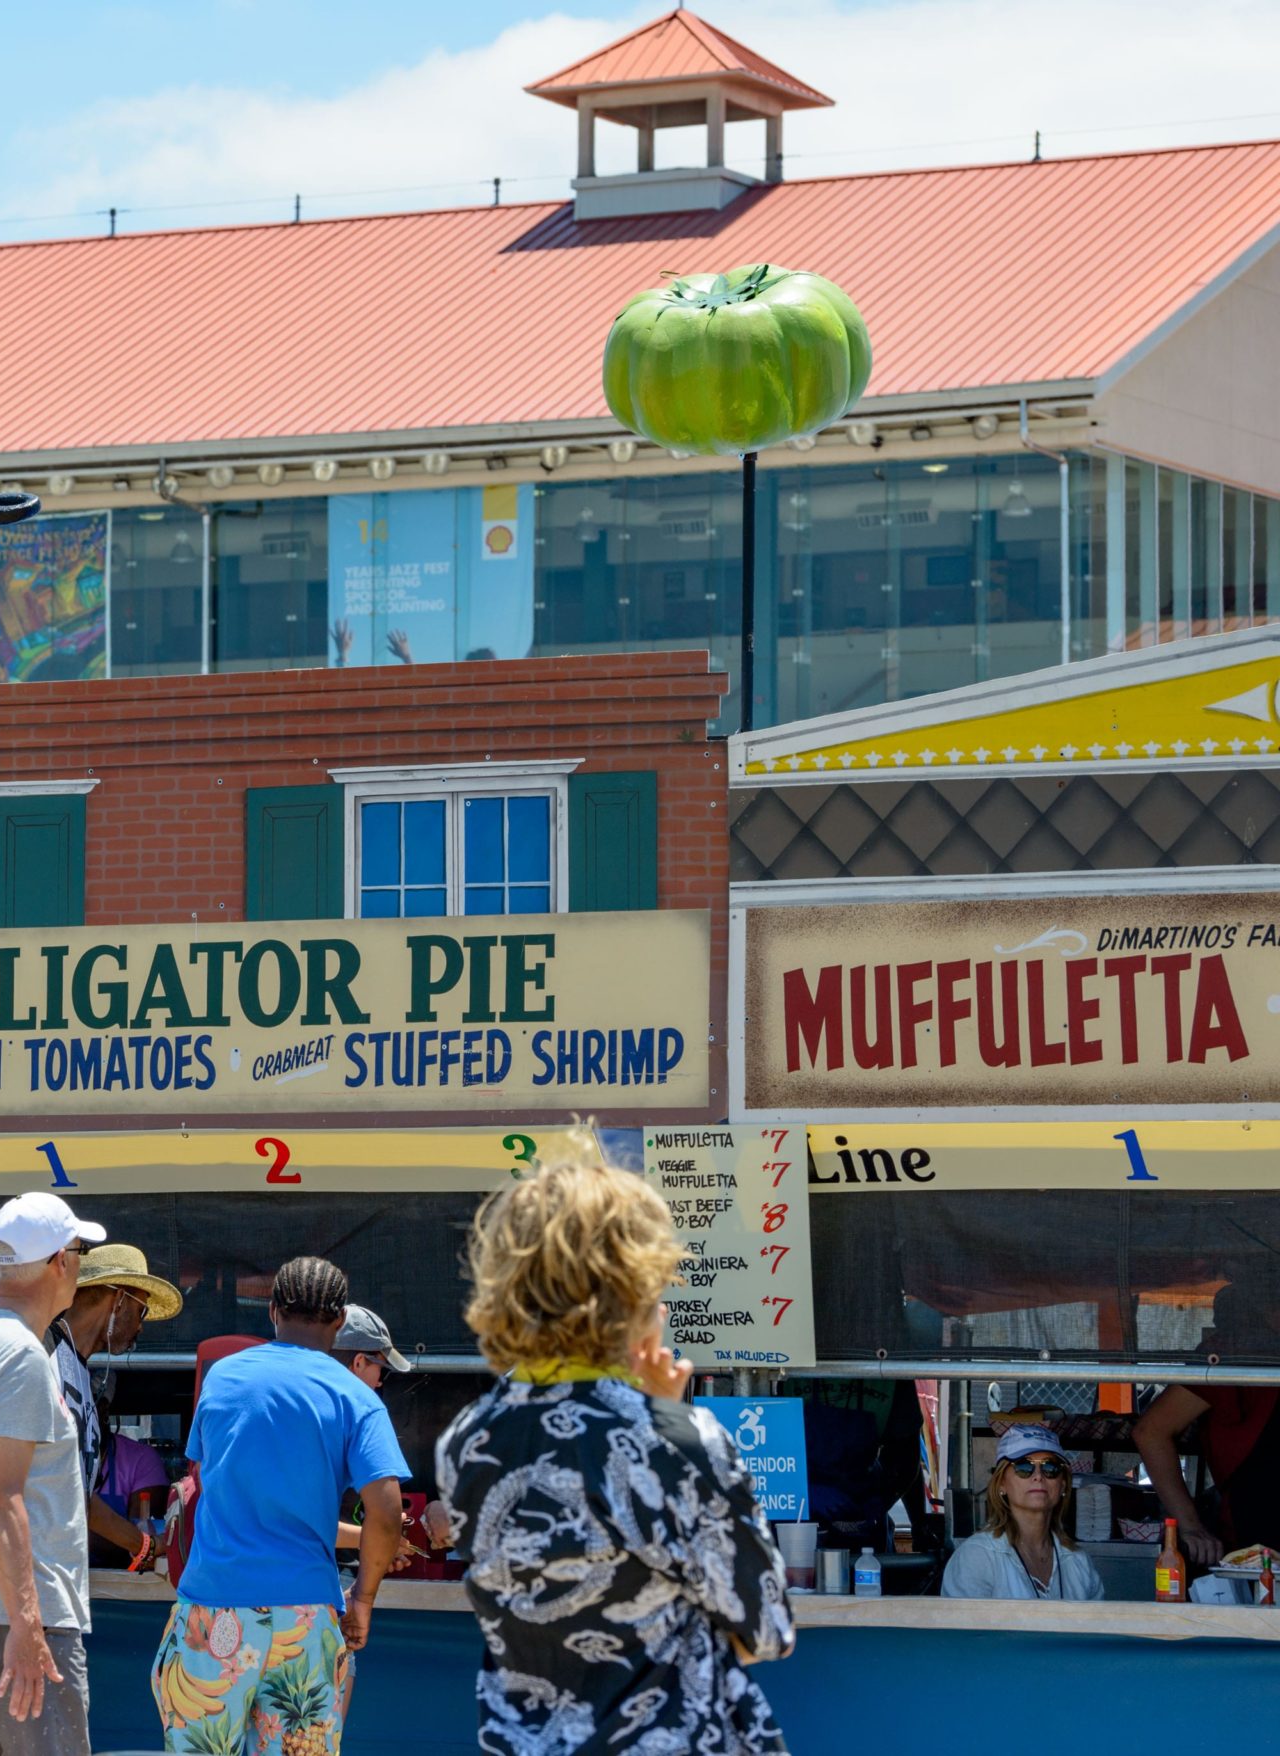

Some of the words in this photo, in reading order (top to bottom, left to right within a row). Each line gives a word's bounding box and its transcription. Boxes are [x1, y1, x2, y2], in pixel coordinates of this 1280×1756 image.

[344, 566, 385, 578] YEARS
[389, 563, 421, 576] JAZZ
[424, 562, 450, 575] FEST
[345, 576, 421, 590] PRESENTING
[345, 603, 373, 615] AND
[376, 599, 445, 614] COUNTING
[1247, 924, 1280, 947] FA
[405, 933, 555, 1023] PIE
[783, 953, 1250, 1073] MUFFULETTA
[24, 1034, 216, 1092] TOMATOES
[252, 1034, 335, 1081] CRABMEAT
[344, 1028, 512, 1088] STUFFED
[531, 1027, 684, 1085] SHRIMP
[761, 1129, 790, 1153] $7
[35, 1141, 78, 1187] 1
[254, 1137, 301, 1184] 2
[502, 1134, 541, 1180] 3
[807, 1133, 936, 1184] Line
[1113, 1129, 1159, 1181] 1
[658, 1160, 697, 1172] VEGGIE
[762, 1162, 792, 1188] $7
[662, 1173, 738, 1189] MUFFULETTA
[696, 1199, 733, 1212] BEEF
[761, 1202, 789, 1233] $8
[760, 1245, 791, 1275] $7
[661, 1297, 712, 1313] TURKEY
[761, 1296, 794, 1326] $7
[670, 1311, 754, 1328] GIARDINERA
[673, 1329, 715, 1344] SALAD
[714, 1350, 731, 1360] TAX
[734, 1350, 789, 1363] INCLUDED
